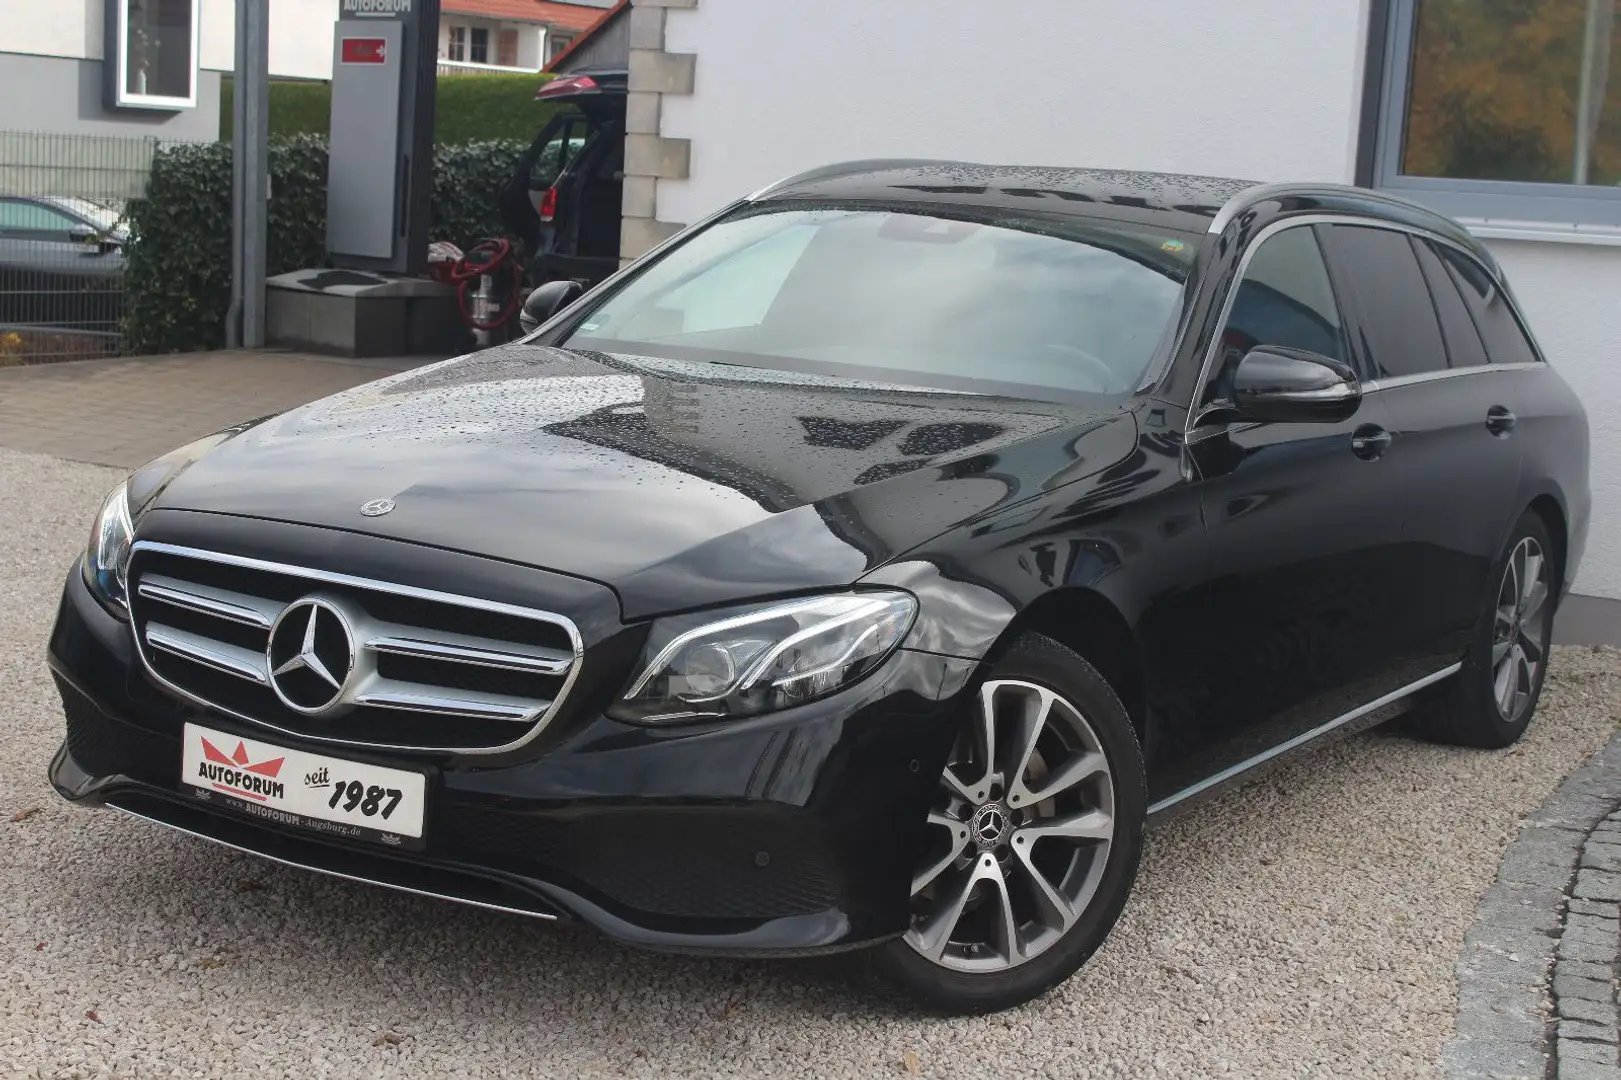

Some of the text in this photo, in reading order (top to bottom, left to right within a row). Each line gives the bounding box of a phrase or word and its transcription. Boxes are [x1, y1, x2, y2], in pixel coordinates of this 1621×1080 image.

[343, 0, 411, 12] AUTOFORUM
[198, 762, 284, 799] AUTOFORUM
[304, 767, 403, 820] seit 1987
